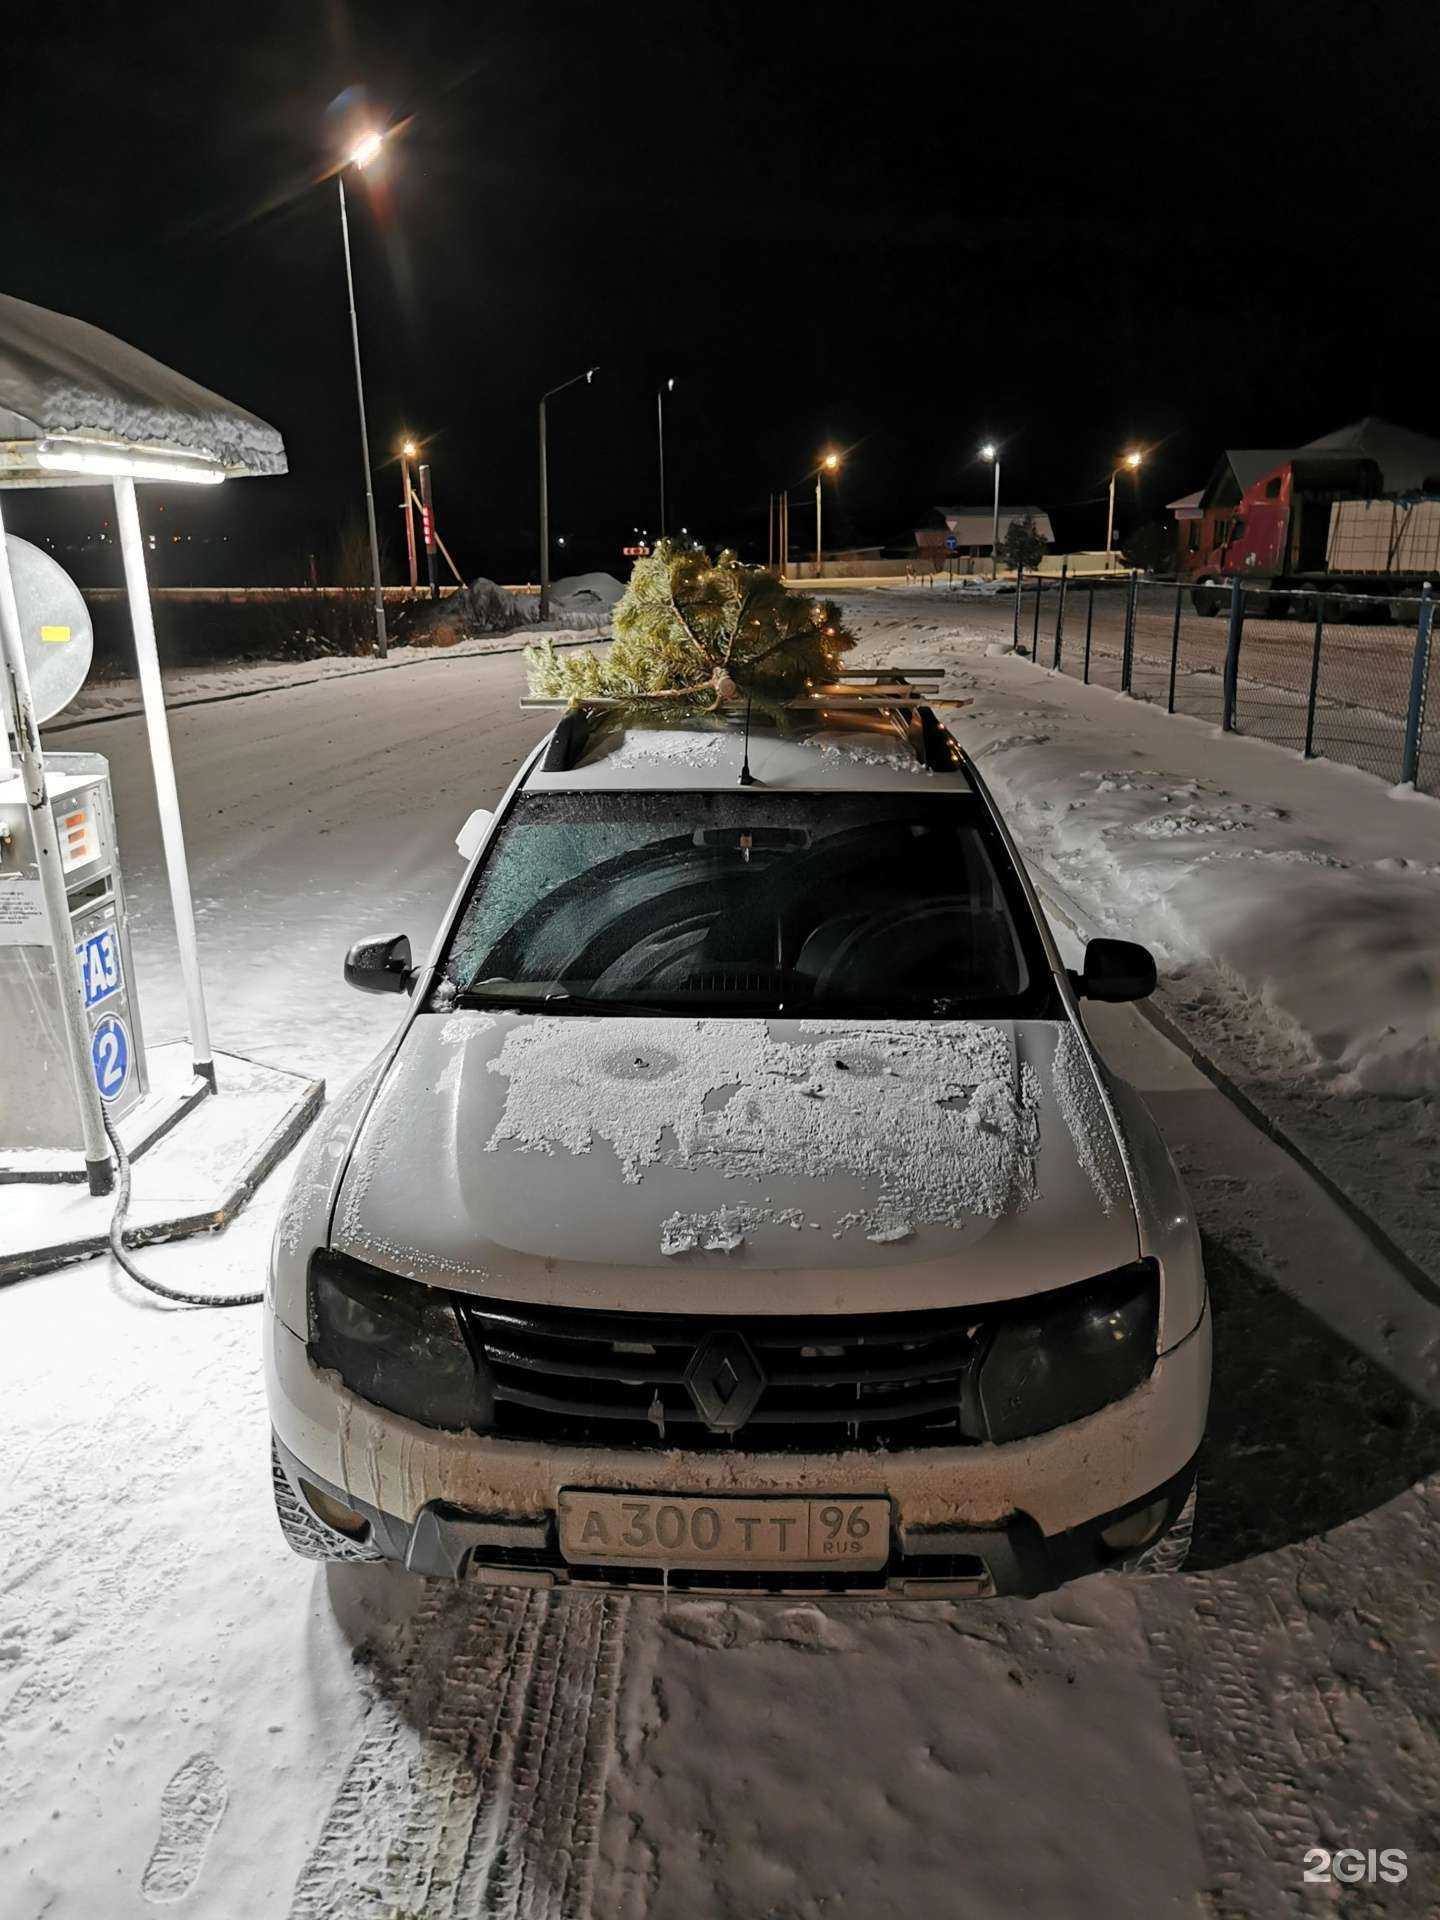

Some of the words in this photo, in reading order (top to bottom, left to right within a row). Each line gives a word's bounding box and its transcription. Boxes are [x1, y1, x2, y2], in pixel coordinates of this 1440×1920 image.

[99, 1032, 122, 1088] 2
[621, 1503, 721, 1550] 300
[819, 1506, 870, 1539] 96
[823, 1541, 863, 1554] RUS
